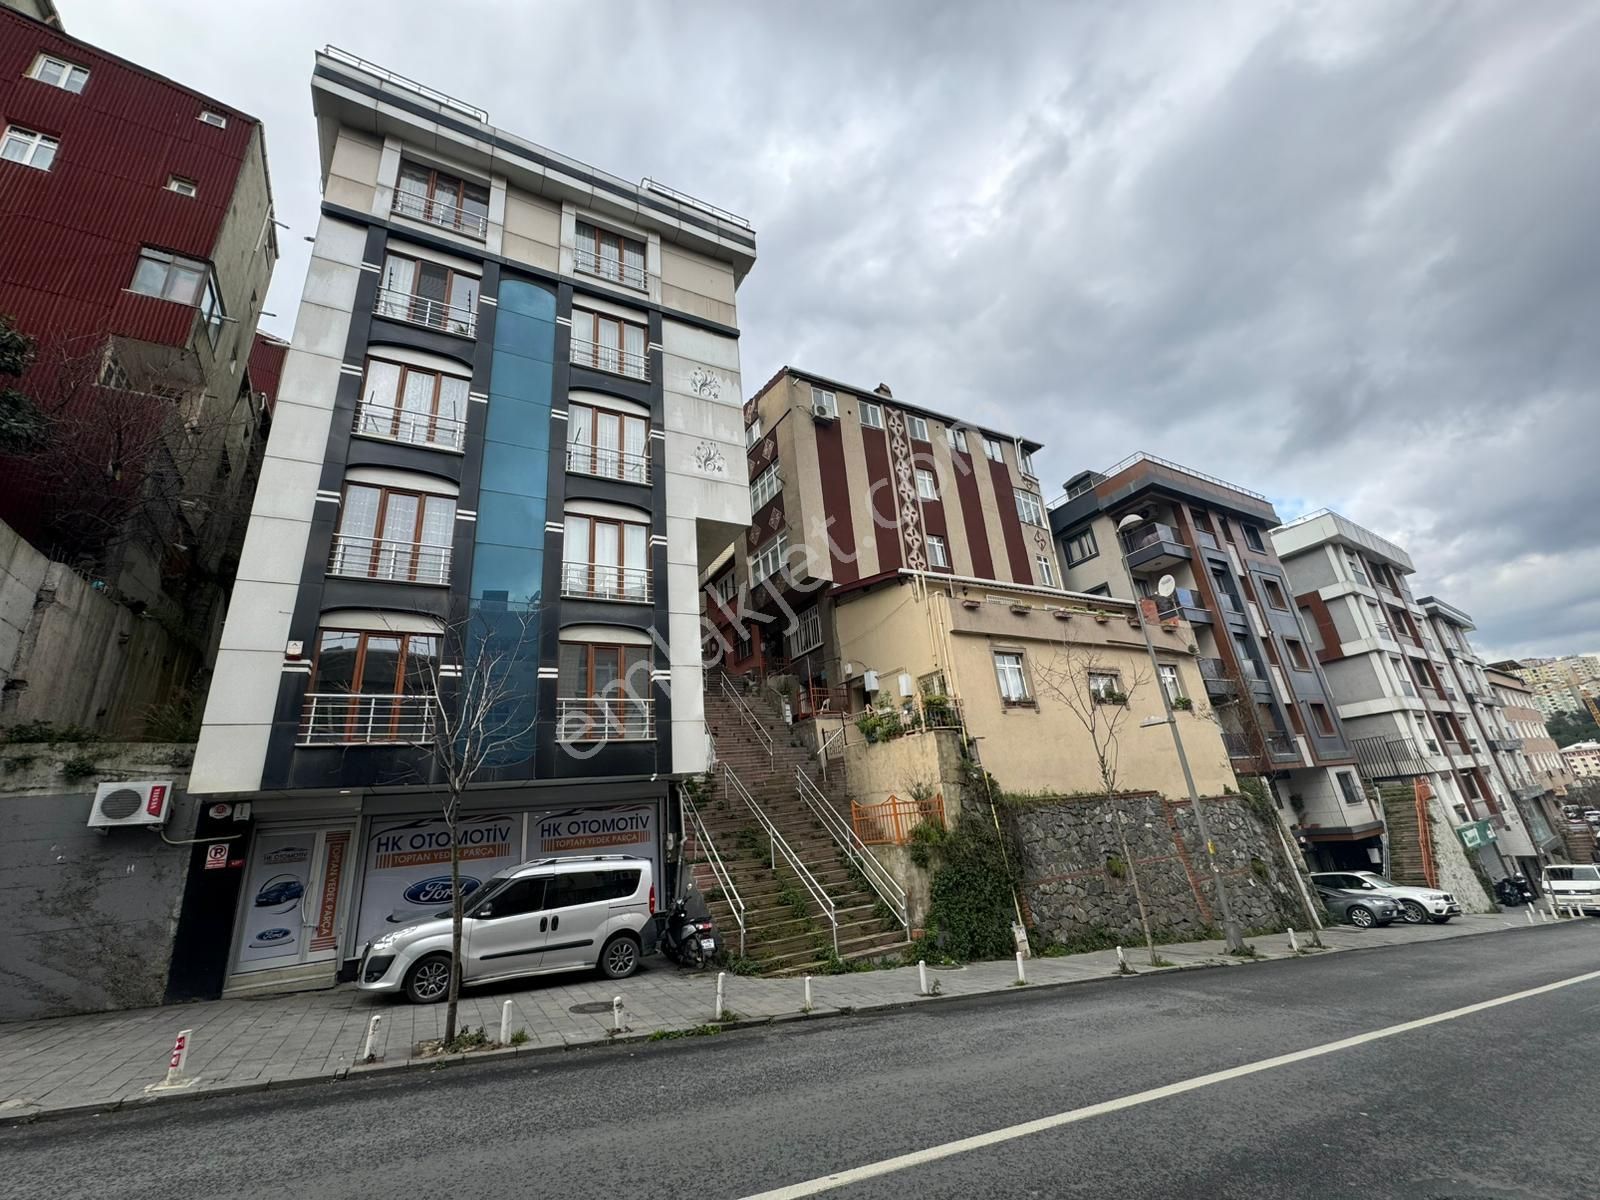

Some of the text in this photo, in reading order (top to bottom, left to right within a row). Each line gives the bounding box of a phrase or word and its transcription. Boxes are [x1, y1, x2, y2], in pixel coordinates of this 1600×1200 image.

[541, 813, 650, 838] HK OTOMOTİV
[376, 824, 511, 853] HK OTOMOTİV
[555, 831, 638, 850] TOPTAN YEDEK PARÇA
[393, 852, 431, 864] TOPTAN
[463, 846, 494, 857] PARÇA
[325, 877, 338, 902] YEDEK
[320, 903, 334, 936] PARÇA
